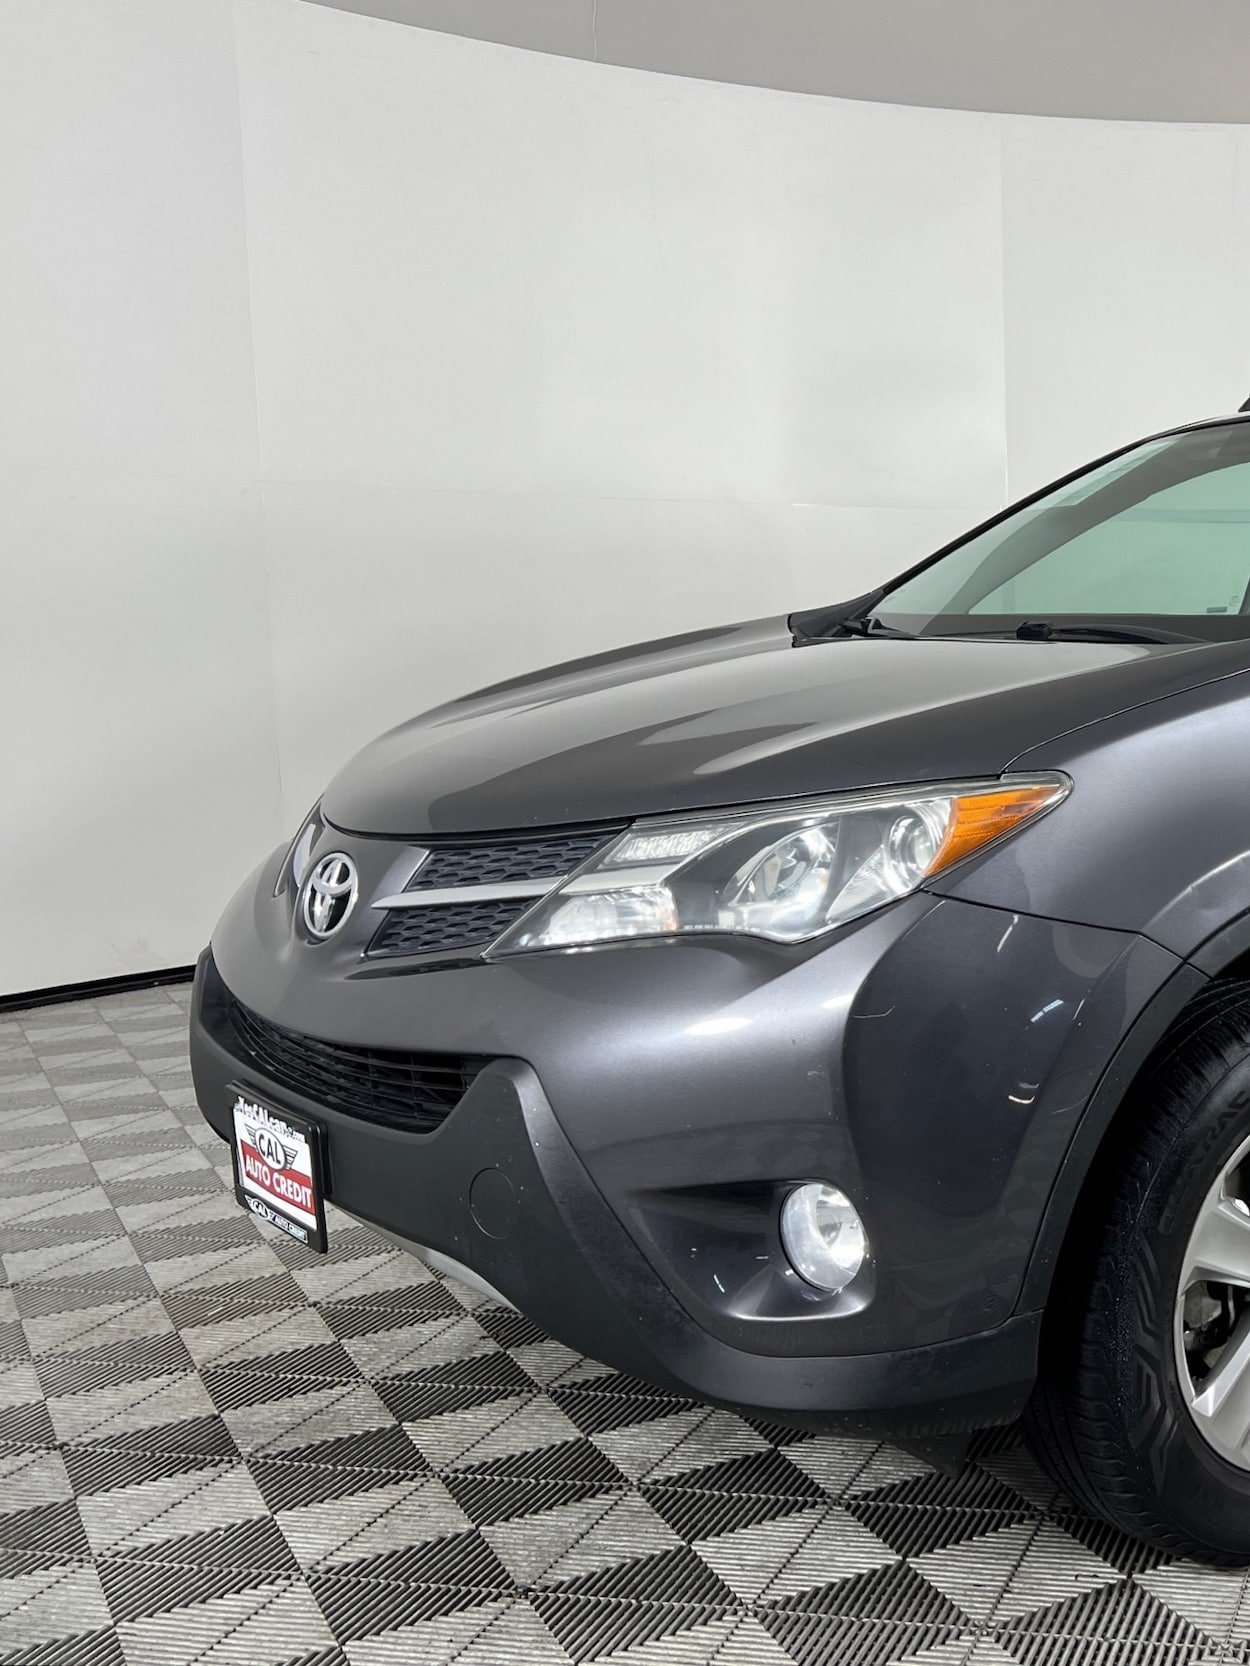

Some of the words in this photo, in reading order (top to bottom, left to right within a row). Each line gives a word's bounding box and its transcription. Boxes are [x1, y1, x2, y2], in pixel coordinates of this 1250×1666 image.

[258, 1133, 282, 1166] CAL
[245, 1154, 271, 1186] AUTO
[272, 1171, 312, 1209] CREDIT
